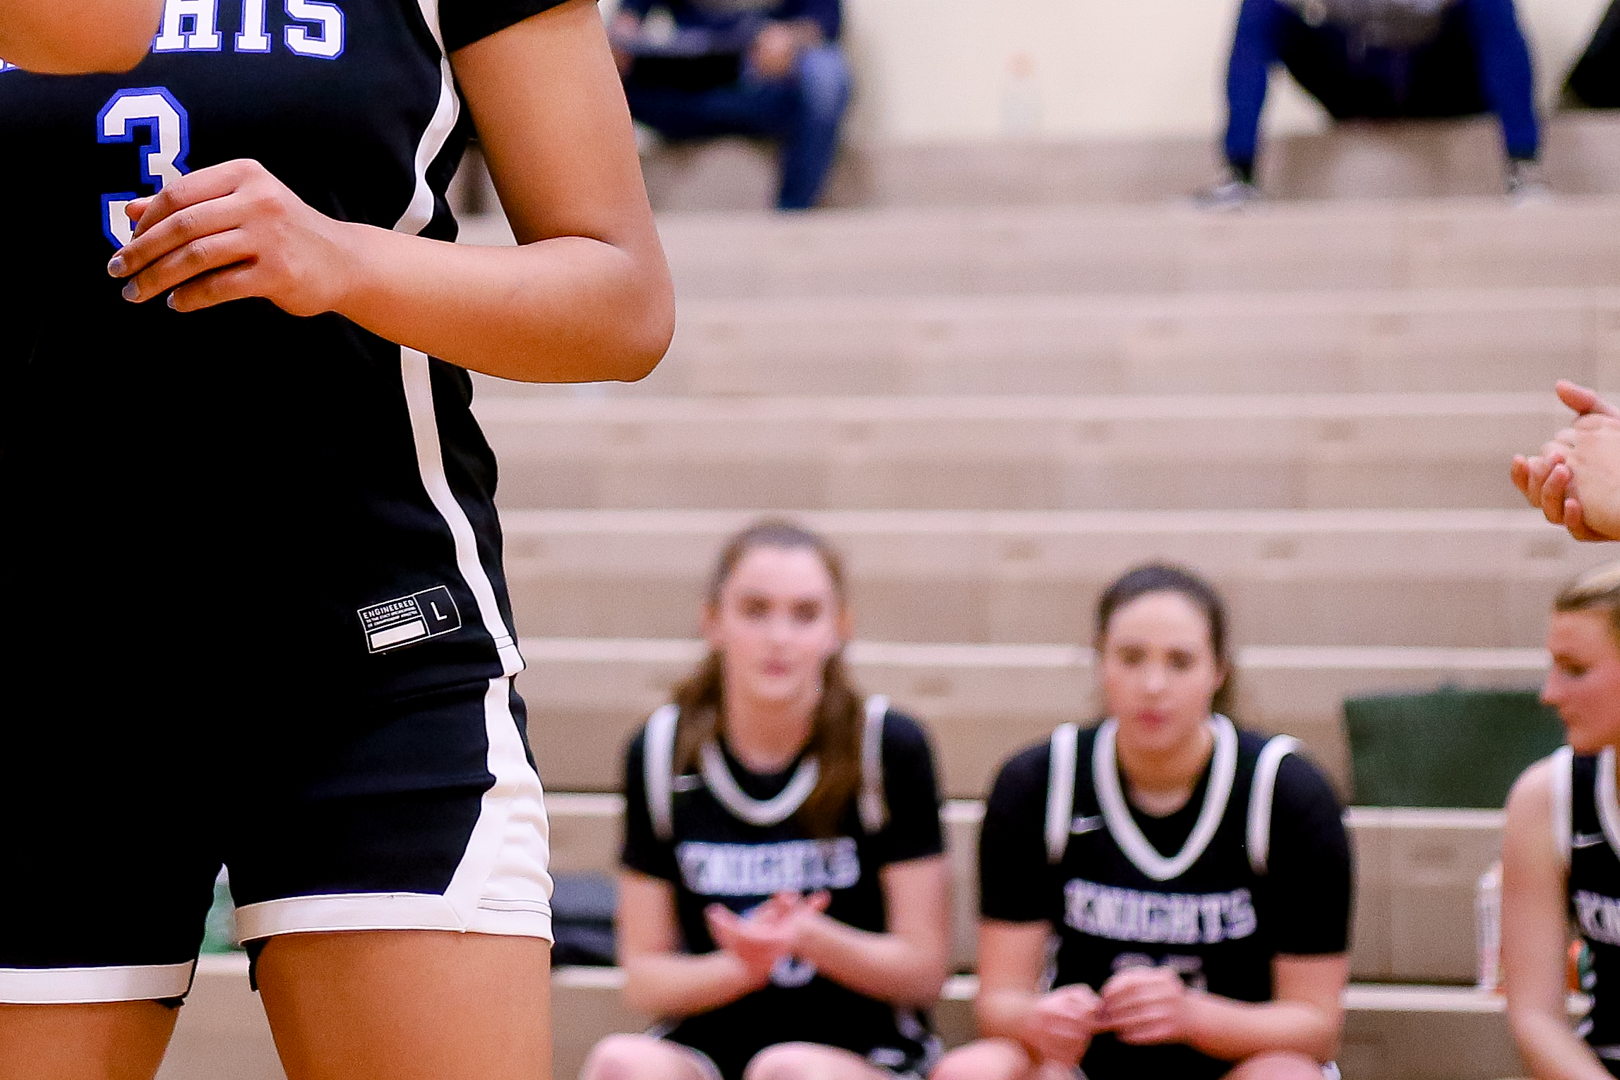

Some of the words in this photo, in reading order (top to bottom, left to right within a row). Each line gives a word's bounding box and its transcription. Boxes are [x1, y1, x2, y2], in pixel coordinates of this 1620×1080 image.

[97, 86, 191, 250] 3
[362, 599, 415, 620] ENGINEERED
[430, 601, 448, 621] L
